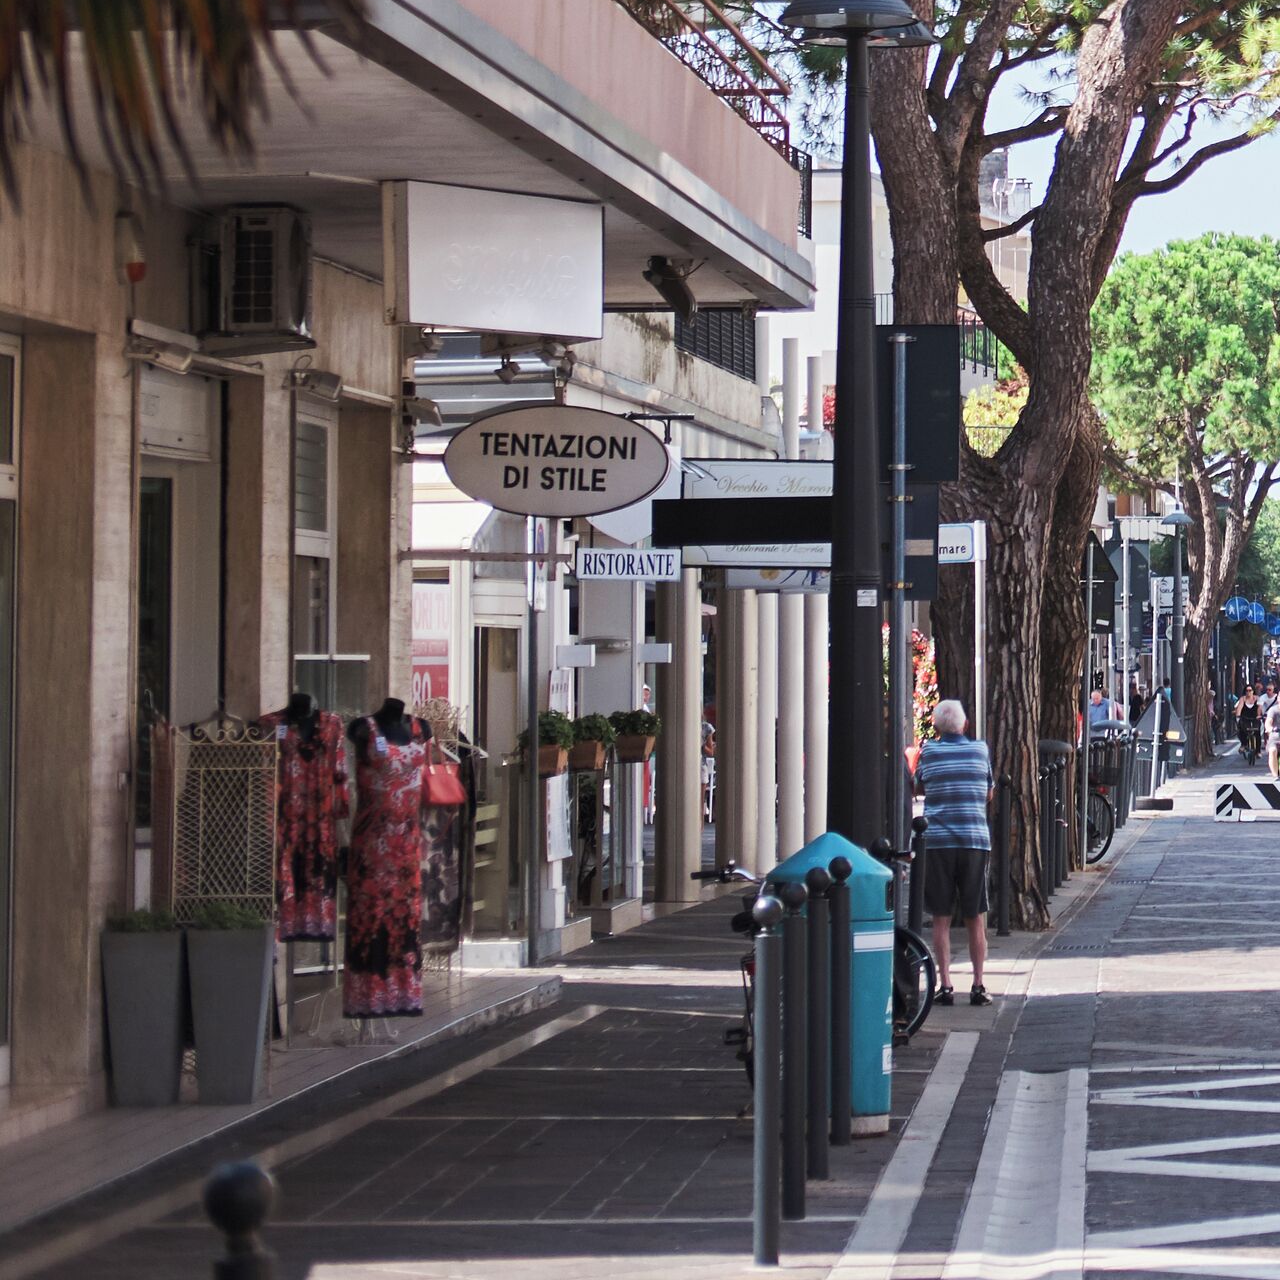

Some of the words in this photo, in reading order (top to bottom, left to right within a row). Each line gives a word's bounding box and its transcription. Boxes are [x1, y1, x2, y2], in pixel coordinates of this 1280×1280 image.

[480, 432, 637, 460] TENTAZIONI
[503, 466, 528, 489] DI
[540, 467, 607, 492] STILE
[716, 474, 769, 494] Vecchio
[583, 553, 675, 576] RISTORANTE
